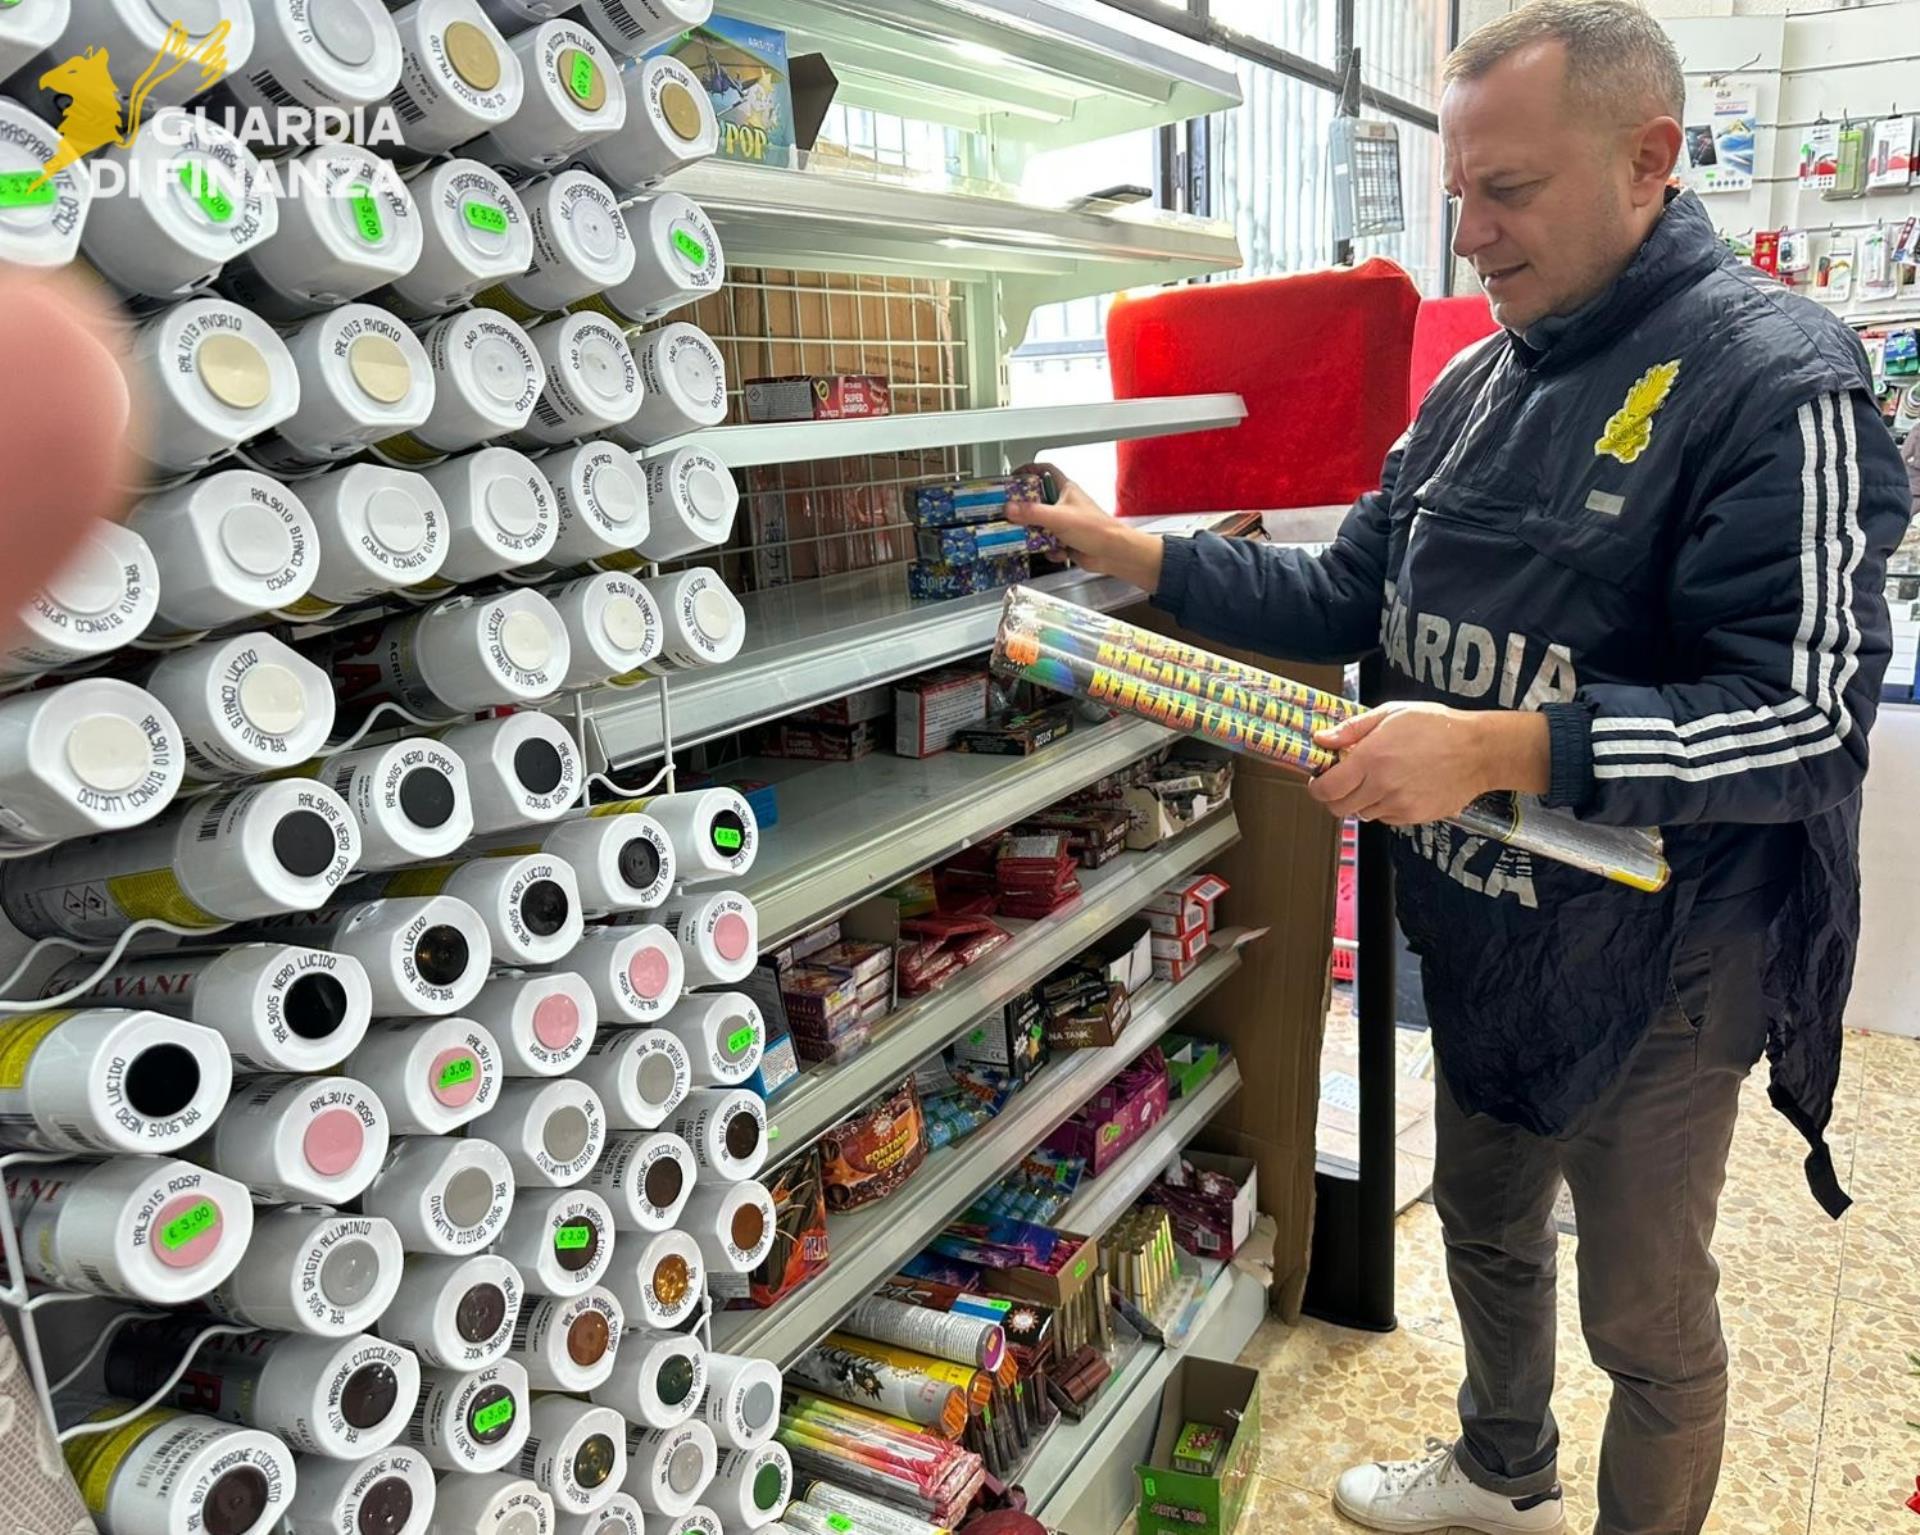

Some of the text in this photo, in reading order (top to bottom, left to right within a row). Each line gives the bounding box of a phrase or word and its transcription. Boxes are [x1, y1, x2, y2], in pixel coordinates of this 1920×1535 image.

[565, 31, 595, 57] PALLIDO
[725, 120, 768, 160] POP
[51, 195, 79, 236] OPACO
[180, 313, 243, 374] RAL 1013 AVORIO
[334, 318, 402, 358] RAL 1013 AVORIO
[573, 324, 624, 351] TRASPARENTE
[621, 352, 635, 394] LUCIDO
[464, 322, 538, 412] 040 TRASPARENTE LUCIDO
[526, 477, 549, 521] RAL9010
[250, 487, 305, 592] RAL9010 BIANCO OPACO
[361, 510, 438, 570] RAL9010 BIANCO OPACO
[75, 564, 141, 634] RAL9010 BIANCO
[606, 578, 636, 600] RAL9010
[635, 593, 655, 625] BIANCO
[487, 607, 505, 642] LUCIDO
[225, 648, 259, 684] LUCIDO
[490, 644, 513, 678] BIANCO
[221, 684, 244, 729] BIANCO
[1087, 668, 1199, 731] BENGALA
[241, 729, 287, 753] RAL9010
[557, 742, 574, 784] RAL9005
[77, 714, 170, 813] RAL9010 BIANCO LUCIDO
[384, 764, 404, 809] RAL9005
[402, 750, 424, 769] NERO
[427, 750, 455, 776] OPACO
[525, 795, 551, 810] OPACO
[298, 793, 350, 887] RAL9005 NERO OPACO
[508, 866, 553, 947] RAL9005 NERO LUCIDO
[402, 915, 455, 1001] RAL9005 NERO LUCIDO
[267, 953, 338, 1044] RAL9005 NERO LUCIDO
[449, 1060, 472, 1077] 3.00
[465, 1033, 494, 1104] RAL3015 ROSA
[528, 1037, 583, 1064] RAL3015 ROSA
[106, 1057, 202, 1138] RAL9005 NERO LUCIDO
[309, 1091, 377, 1128] RAL3015 ROSA
[536, 1151, 573, 1177] ALLUMINIO
[576, 1143, 596, 1172] GRIGIO
[133, 1173, 202, 1247] RAL3015 ROSA
[495, 1181, 507, 1201] RAL
[169, 1206, 211, 1240] € 3.00
[320, 1220, 372, 1249] ALLUMINIO
[430, 1195, 453, 1242] ALLUMINIO
[456, 1225, 488, 1245] GRIGIO
[303, 1248, 323, 1292] GRIGIO
[330, 1308, 345, 1325] RAL
[486, 1318, 514, 1354] MARRONE
[464, 1346, 485, 1360] NOCE
[327, 1363, 353, 1409] MARRONE
[351, 1346, 403, 1368] CIOCCOLATO
[455, 1380, 478, 1421] MARRONE
[478, 1367, 499, 1382] NOCE
[157, 1450, 193, 1499] MARRONE
[191, 1475, 210, 1505] 8017
[210, 1447, 253, 1477] MARRONE
[252, 1448, 283, 1504] CIOCCOLATO
[352, 1457, 413, 1498] MARRONE NOCE
